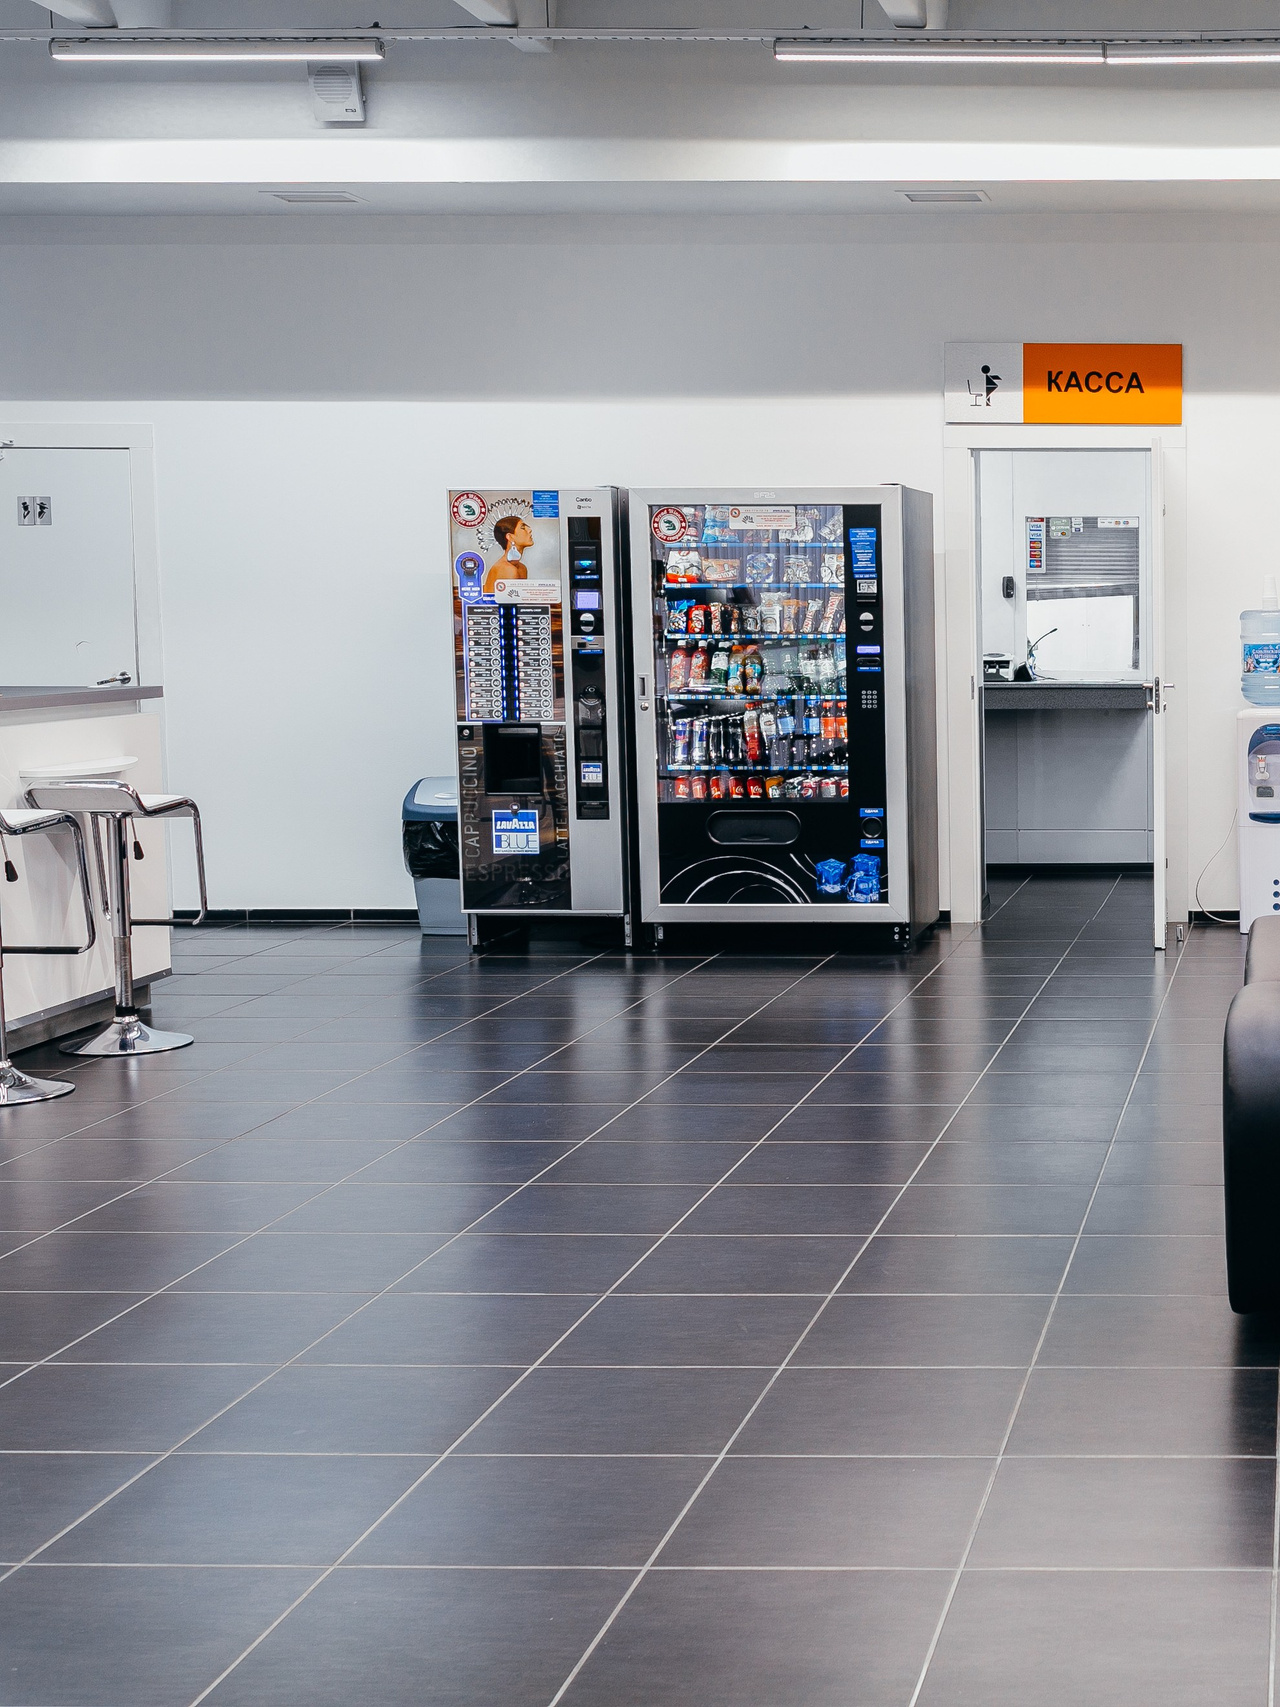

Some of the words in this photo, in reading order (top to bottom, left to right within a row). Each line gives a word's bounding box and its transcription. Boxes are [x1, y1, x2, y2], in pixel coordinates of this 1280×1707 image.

[1047, 370, 1145, 394] КАССА
[554, 733, 568, 811] MACCHIATO
[496, 818, 535, 830] LAVAZZA
[495, 834, 538, 849] BLUE
[556, 818, 568, 858] LATTE
[464, 864, 570, 882] ESPRESSO
